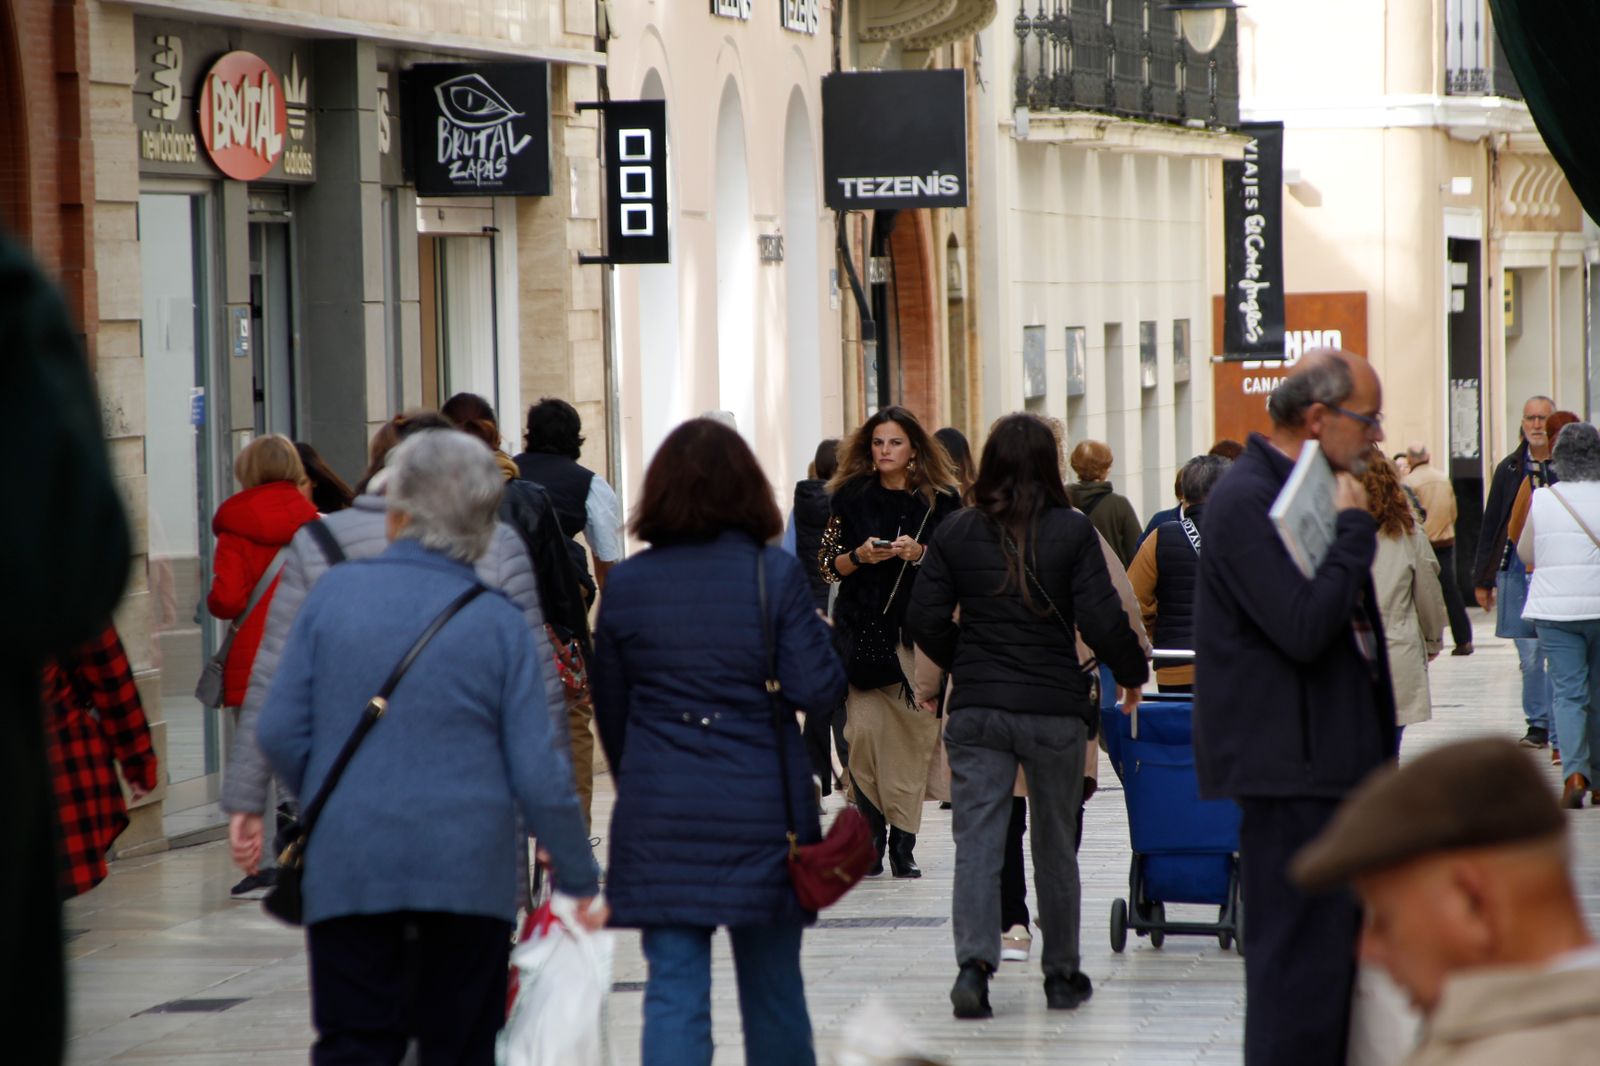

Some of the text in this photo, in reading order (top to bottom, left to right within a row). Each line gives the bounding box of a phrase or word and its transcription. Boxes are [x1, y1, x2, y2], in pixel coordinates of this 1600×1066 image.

[212, 70, 282, 163] BRUTAL
[437, 115, 532, 163] BRUTAL
[449, 157, 508, 186] ZAPAS
[1242, 139, 1259, 210] VIAJES
